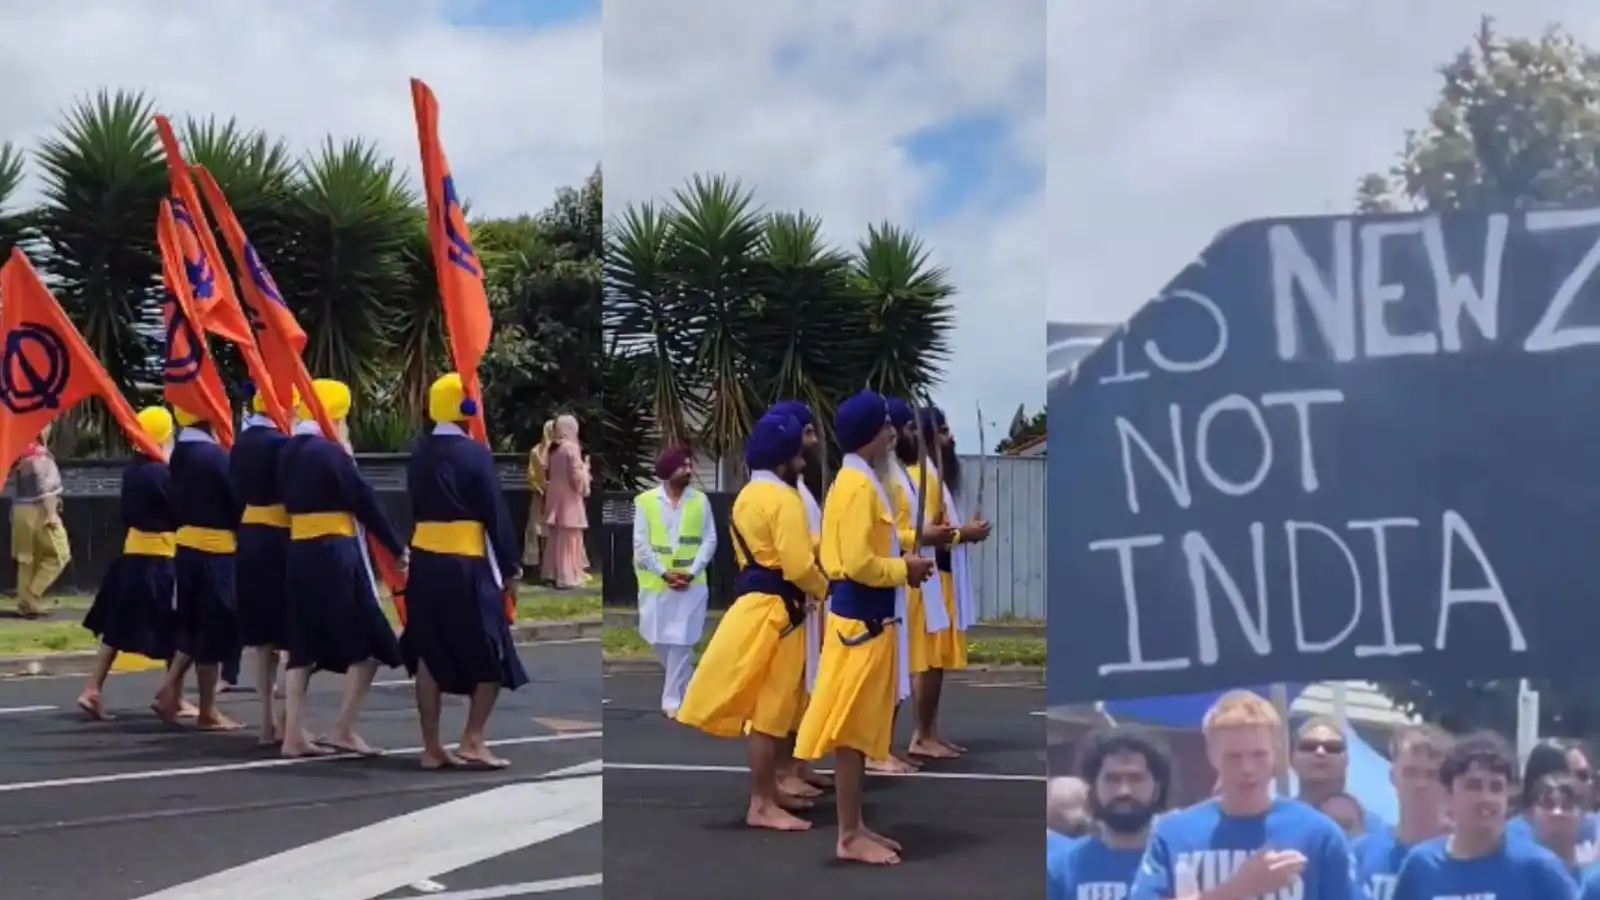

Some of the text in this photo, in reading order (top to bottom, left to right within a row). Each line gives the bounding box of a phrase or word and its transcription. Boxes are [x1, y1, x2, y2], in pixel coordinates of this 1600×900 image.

[1268, 213, 1509, 362] NEW
[1115, 389, 1344, 513] NOT
[1089, 510, 1527, 675] INDIA
